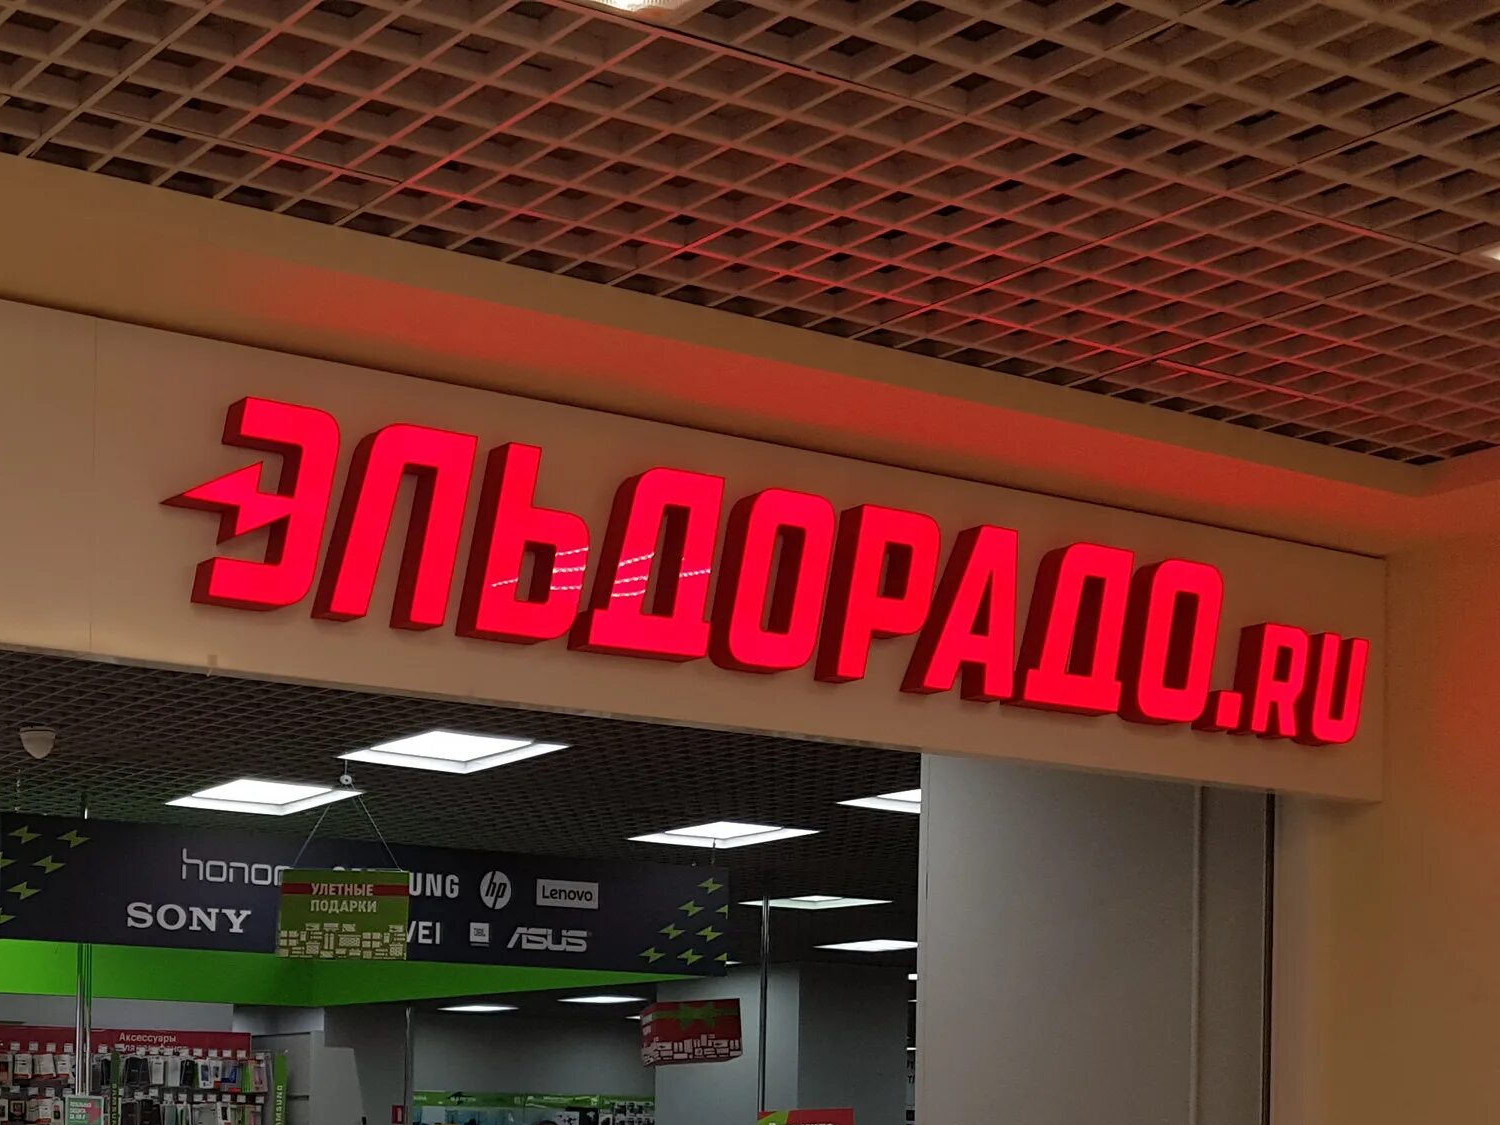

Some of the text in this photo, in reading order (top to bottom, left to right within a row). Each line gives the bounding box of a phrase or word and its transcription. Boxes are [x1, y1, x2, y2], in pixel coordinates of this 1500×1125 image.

[160, 396, 1369, 746] ЭЛЬДОРАДО.RU
[310, 882, 374, 897] УЛЕТНЫЕ
[481, 871, 511, 909] hp
[540, 883, 594, 903] Lenovo
[310, 899, 378, 914] ПОДАРКИ
[126, 901, 252, 934] SONY
[506, 926, 589, 952] ASUS
[118, 1031, 177, 1044] Аксессуары
